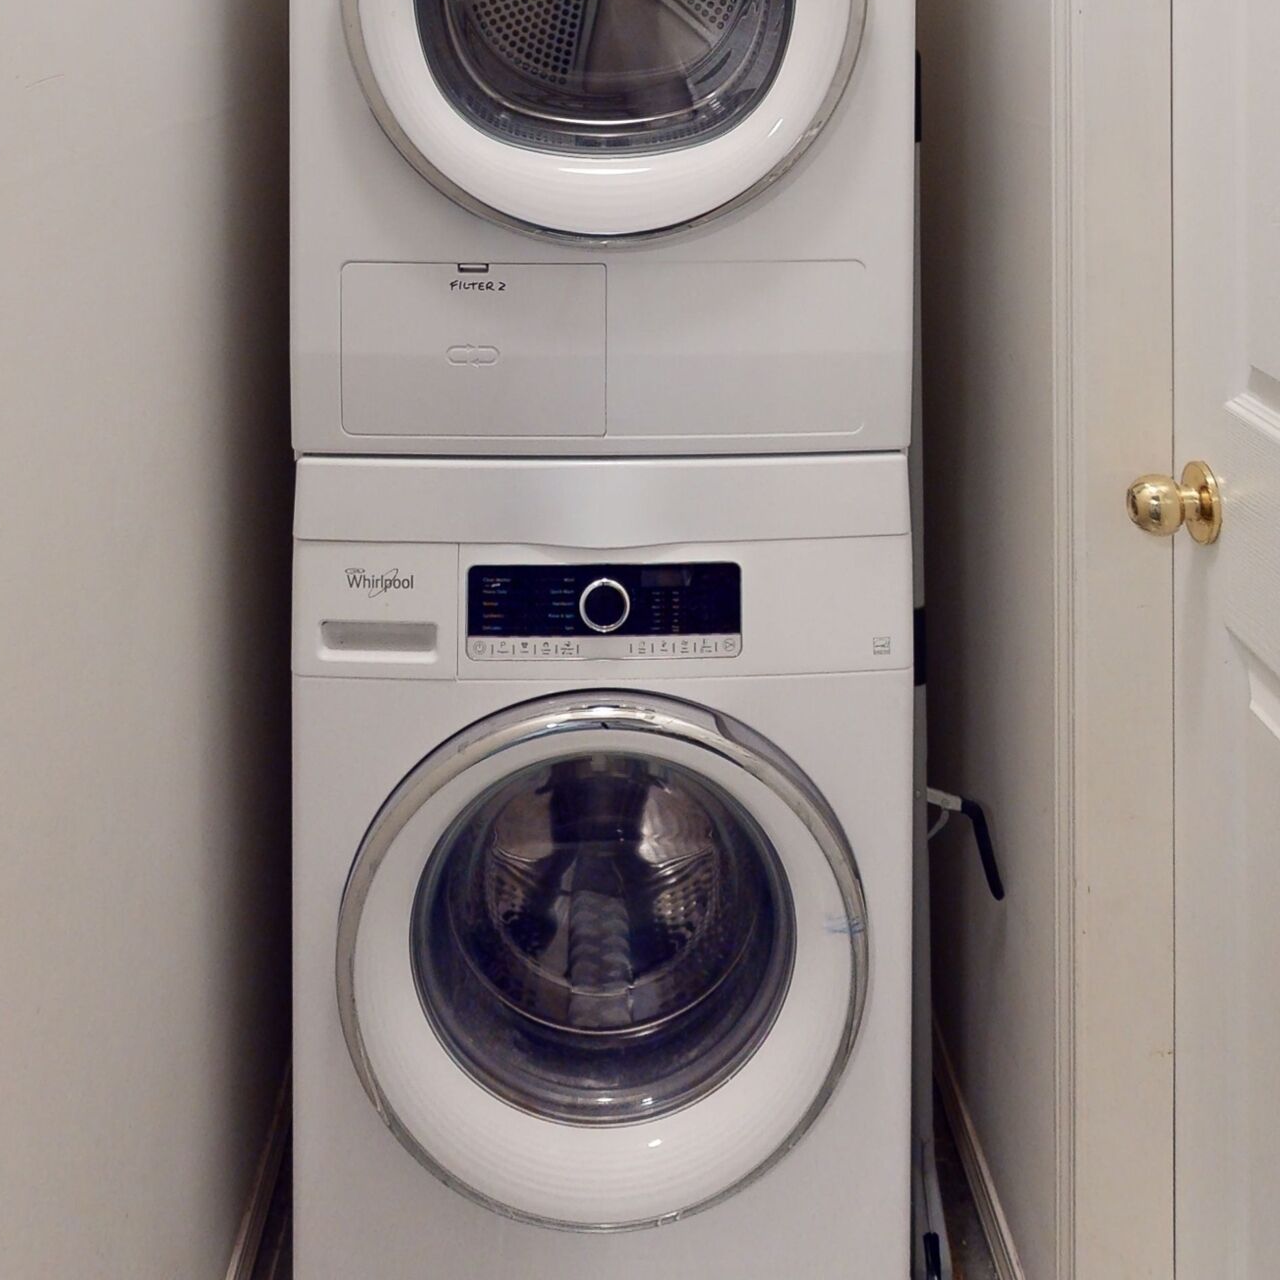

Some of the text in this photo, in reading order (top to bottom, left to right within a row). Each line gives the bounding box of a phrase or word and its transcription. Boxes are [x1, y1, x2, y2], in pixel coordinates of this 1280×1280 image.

[449, 280, 506, 291] FILTER 2
[346, 574, 414, 593] Whirlpool
